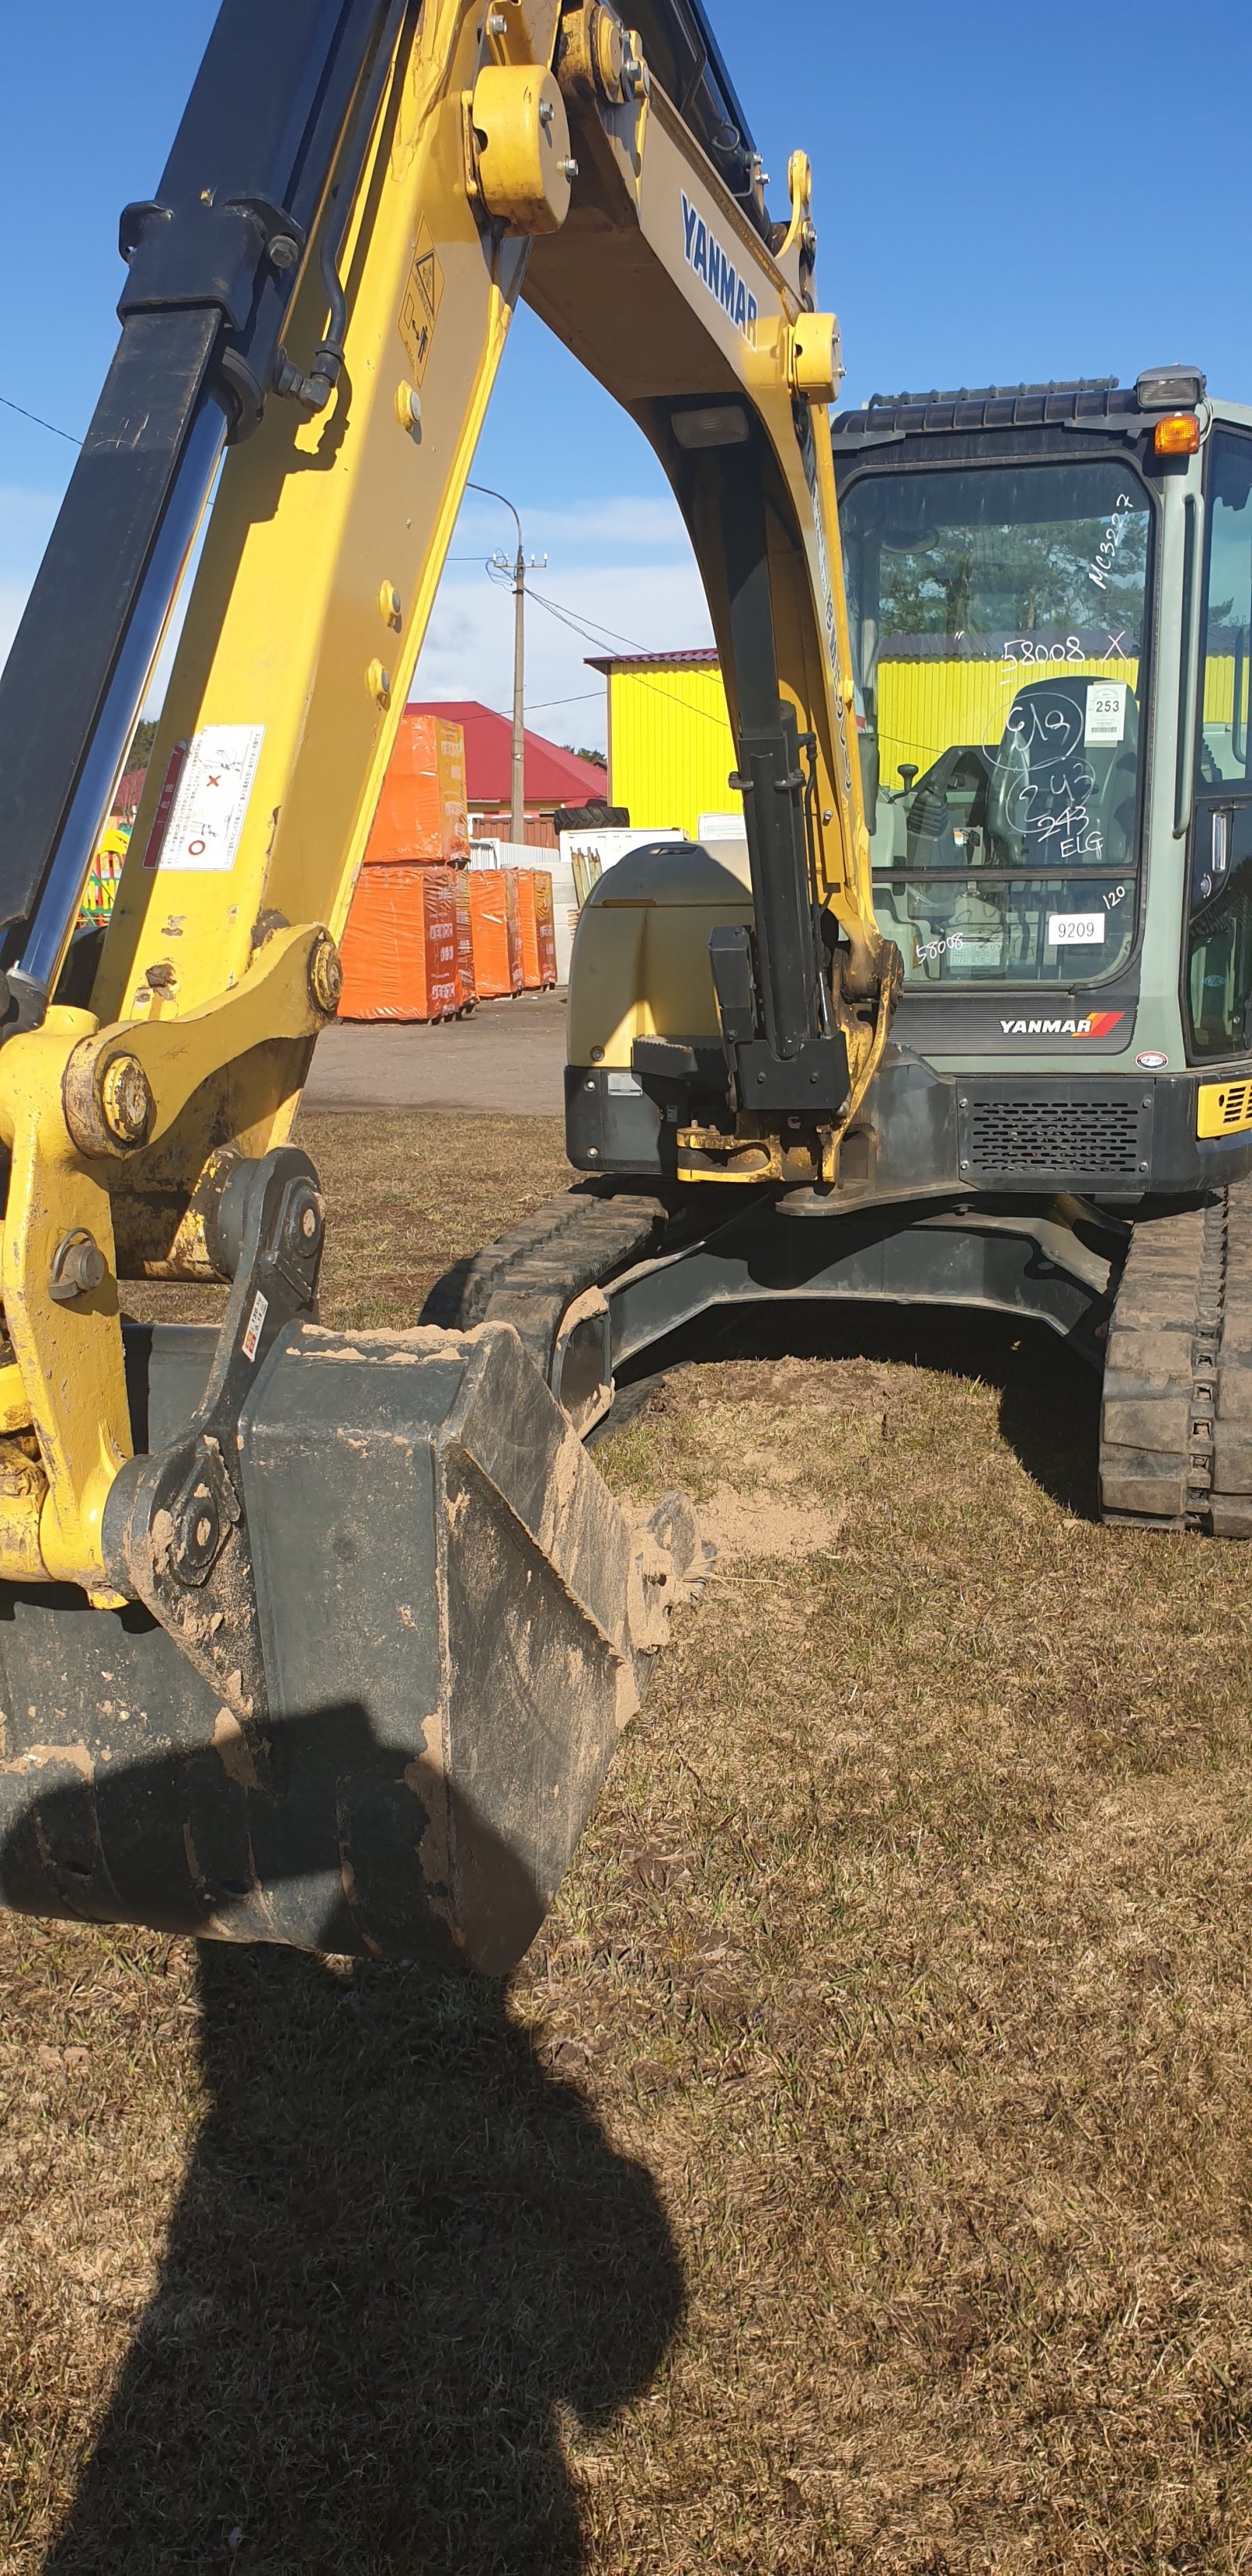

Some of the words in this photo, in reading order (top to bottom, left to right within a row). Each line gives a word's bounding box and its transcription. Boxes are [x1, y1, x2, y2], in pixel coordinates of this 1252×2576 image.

[681, 191, 758, 351] YANMAR
[1001, 636, 1085, 672] 58008
[1096, 701, 1120, 712] 253
[1037, 806, 1089, 842] 243
[1060, 831, 1104, 860] ELG
[1103, 886, 1125, 910] 120
[1058, 922, 1095, 938] 9209
[916, 932, 963, 964] 58008
[1000, 1020, 1092, 1033] YANMAR
